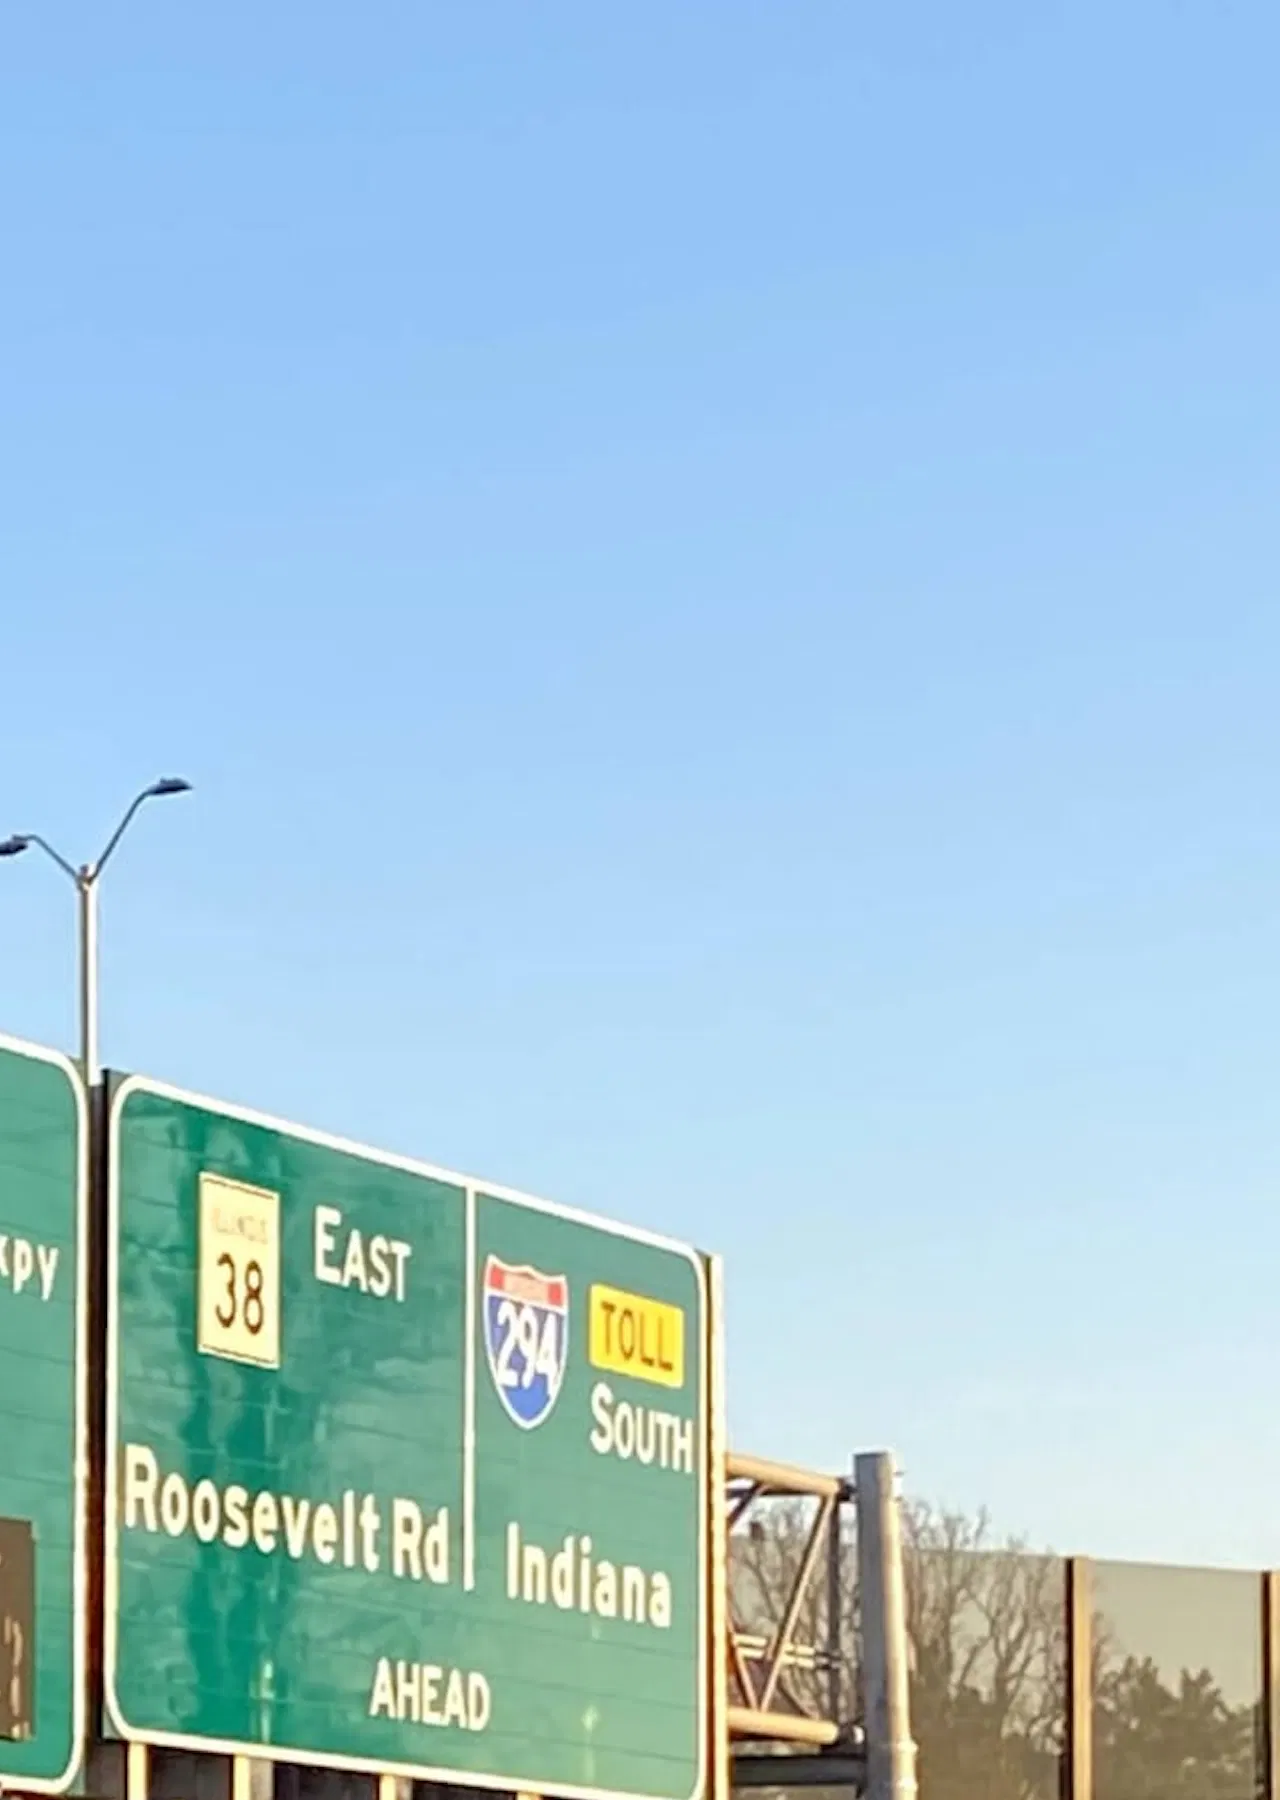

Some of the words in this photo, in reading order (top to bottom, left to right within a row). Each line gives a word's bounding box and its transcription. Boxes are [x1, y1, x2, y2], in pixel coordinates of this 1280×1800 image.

[215, 1252, 264, 1336] 38
[314, 1205, 413, 1302] EAST
[497, 1300, 559, 1398] 294
[600, 1300, 675, 1372] TOLL
[590, 1382, 694, 1474] SOUTH
[124, 1443, 382, 1573] Roosevelt
[392, 1498, 450, 1584] Rd
[507, 1523, 672, 1628] Indiana
[370, 1658, 491, 1732] AHEAD
